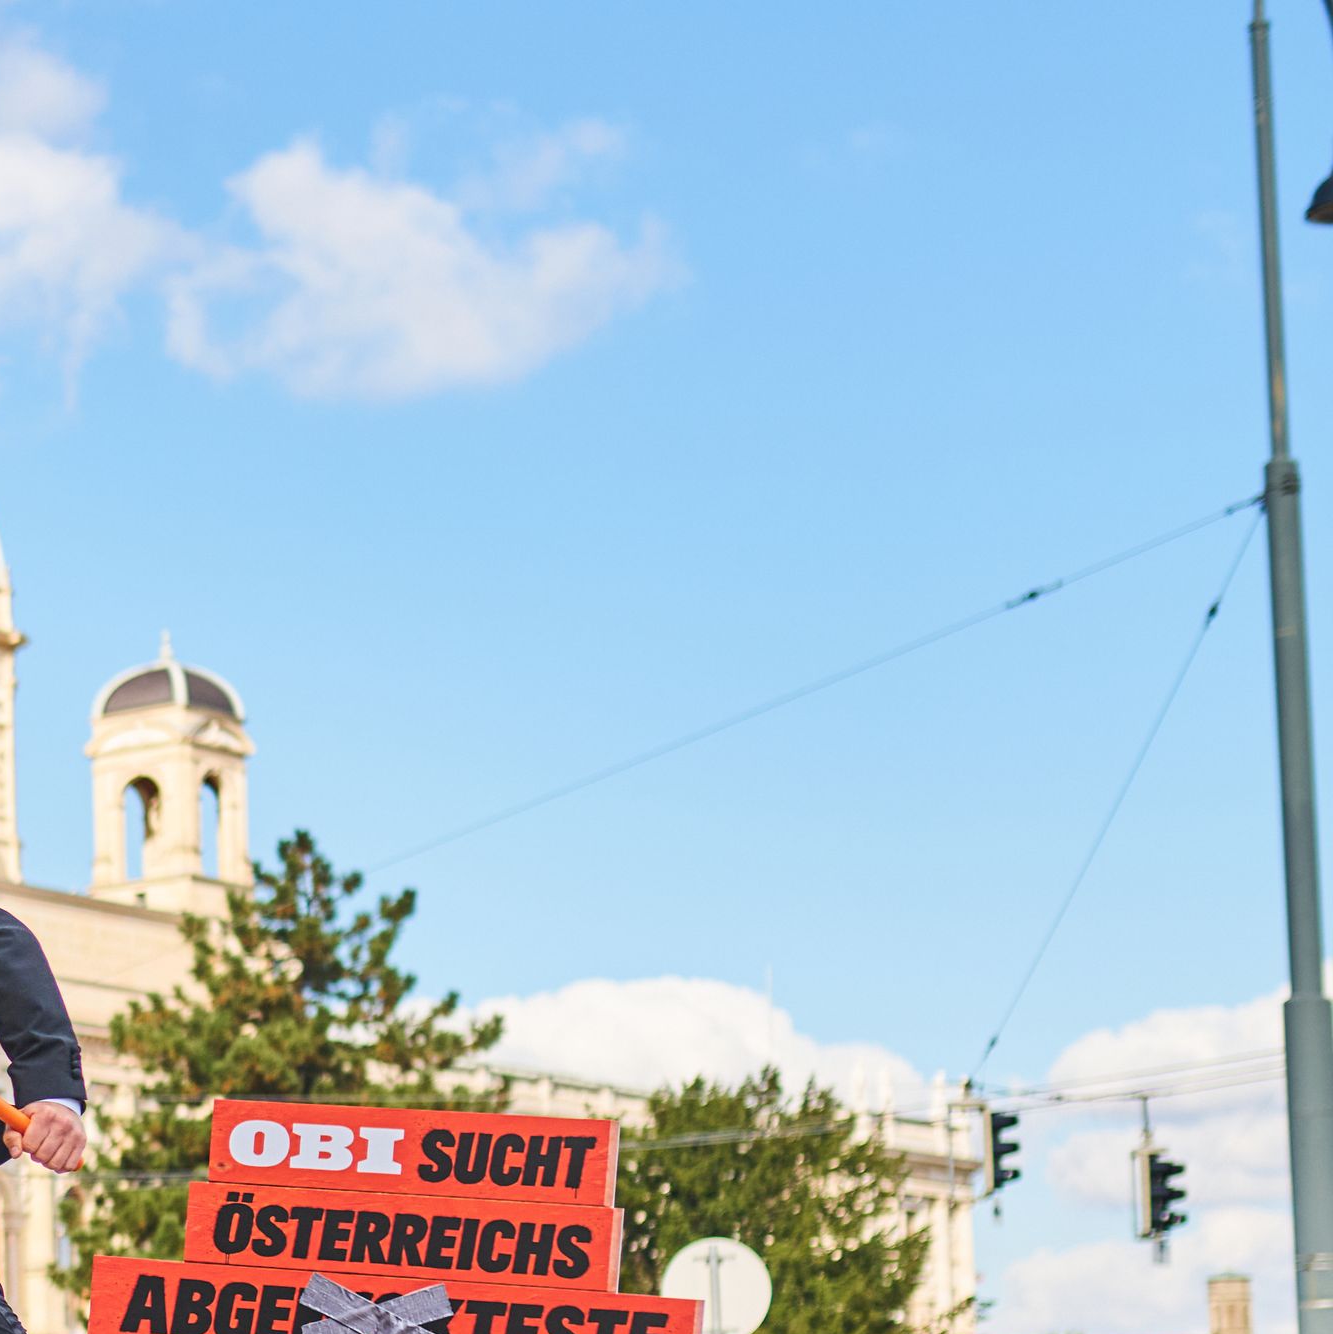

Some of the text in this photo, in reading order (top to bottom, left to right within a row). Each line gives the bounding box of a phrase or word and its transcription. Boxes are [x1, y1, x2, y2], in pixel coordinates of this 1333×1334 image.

[228, 1119, 599, 1190] OBI SUCHT
[212, 1192, 593, 1281] ÖSTERREICHS
